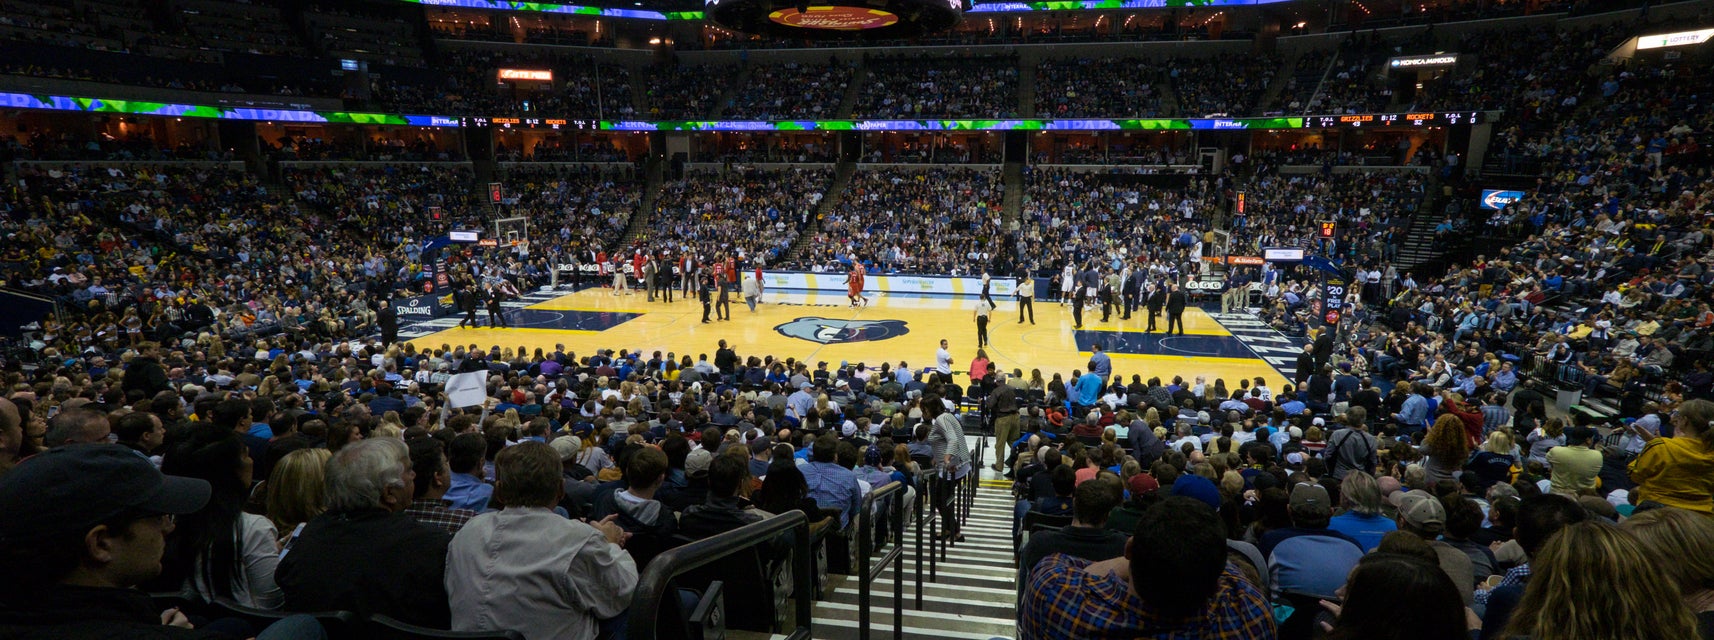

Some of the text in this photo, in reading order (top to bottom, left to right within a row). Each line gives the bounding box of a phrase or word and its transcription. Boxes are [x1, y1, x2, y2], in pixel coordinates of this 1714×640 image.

[1670, 35, 1699, 43] LOTTERY
[1327, 286, 1343, 295] $20
[396, 305, 432, 316] SPALDING
